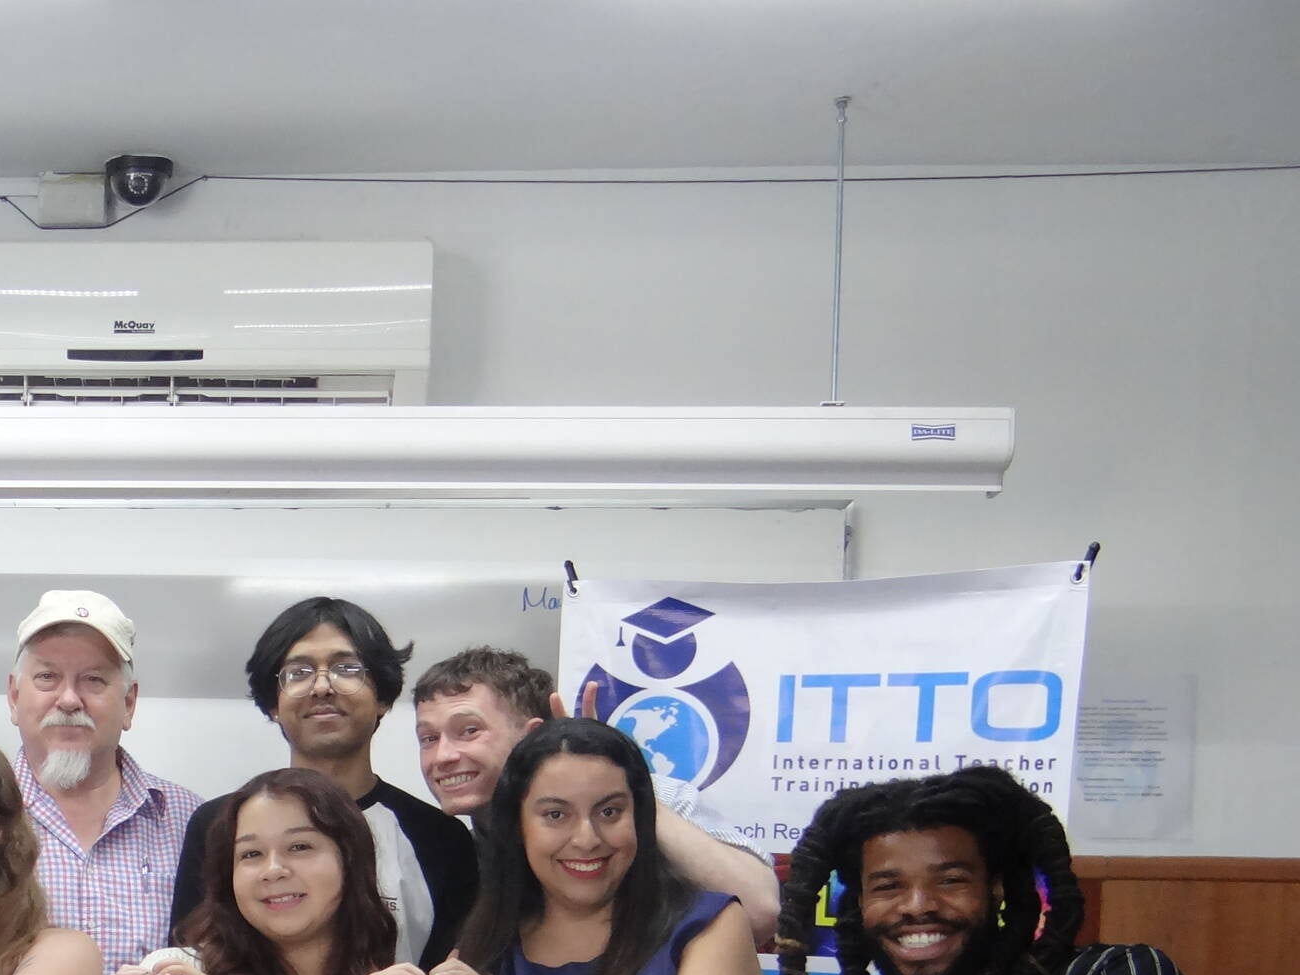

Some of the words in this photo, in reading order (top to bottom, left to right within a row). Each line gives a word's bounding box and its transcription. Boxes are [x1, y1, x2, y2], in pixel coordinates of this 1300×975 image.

[114, 320, 155, 330] McQuay
[776, 670, 1063, 743] ITTO
[772, 754, 941, 771] International
[955, 754, 1057, 771] Teacher
